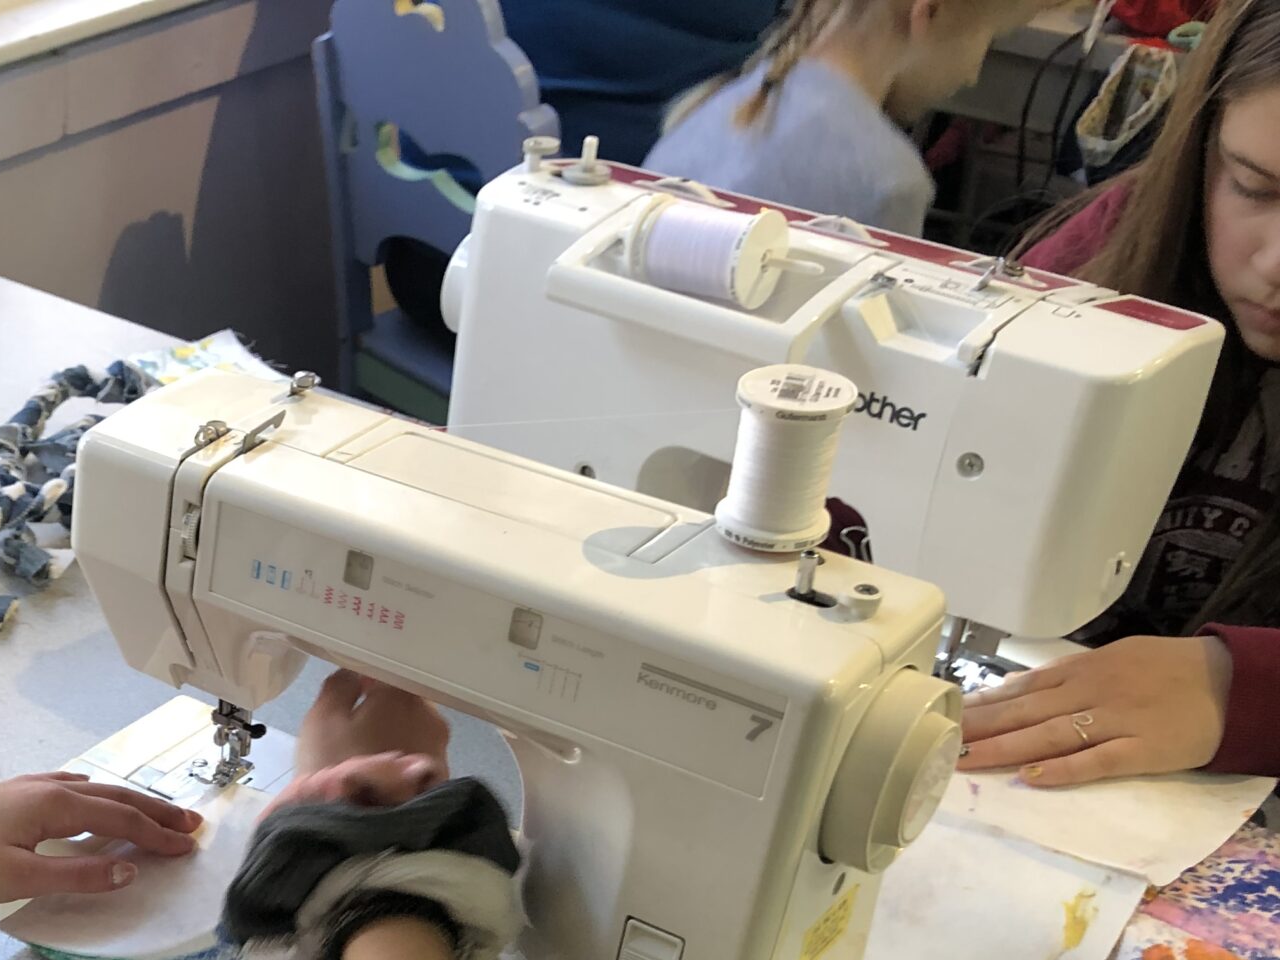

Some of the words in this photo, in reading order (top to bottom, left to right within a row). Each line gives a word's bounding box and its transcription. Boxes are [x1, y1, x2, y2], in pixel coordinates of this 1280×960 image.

[854, 391, 927, 431] other
[636, 671, 718, 711] Kenmore
[745, 714, 773, 742] 7
